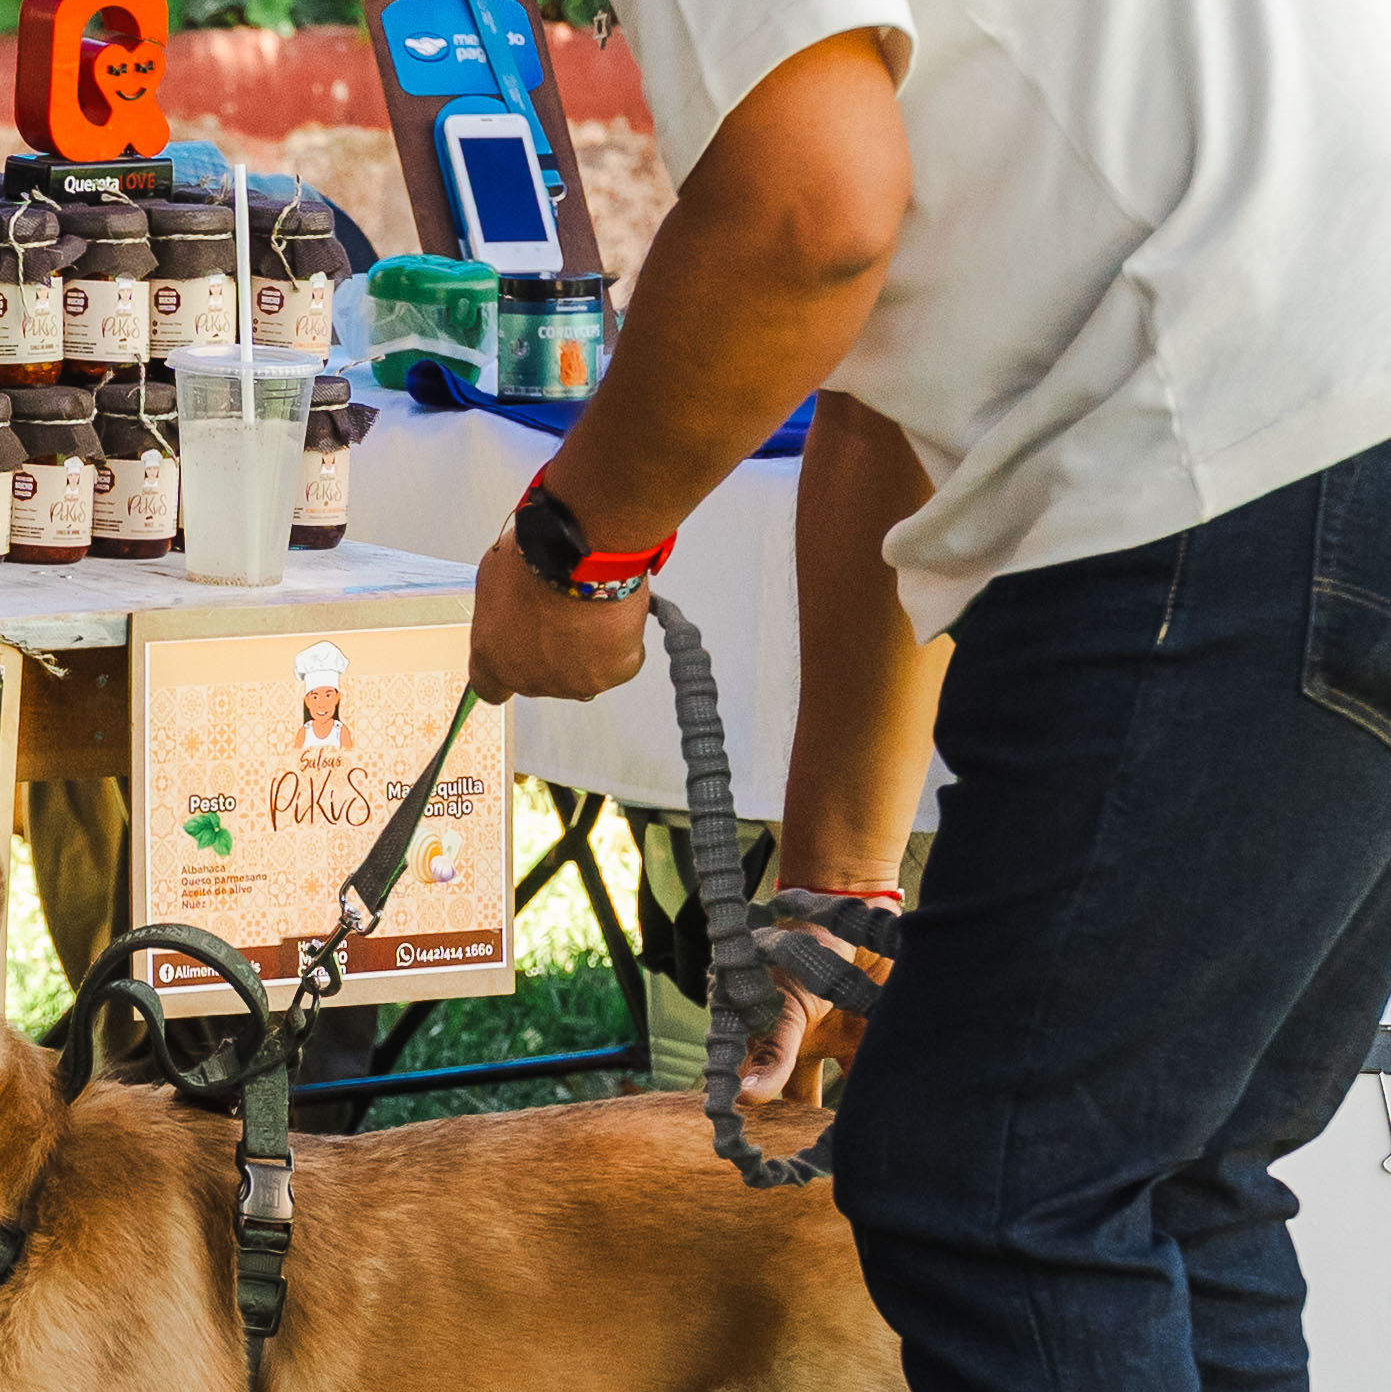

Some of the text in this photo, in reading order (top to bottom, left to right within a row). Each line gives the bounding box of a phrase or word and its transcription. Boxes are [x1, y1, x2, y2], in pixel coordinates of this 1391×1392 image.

[300, 748, 343, 772] Salsas
[189, 793, 237, 814] Pesto
[270, 767, 370, 832] PiKiS
[423, 795, 473, 819] on ajo
[181, 864, 226, 875] Albahaca
[181, 873, 268, 886] Queso parmesano
[181, 888, 212, 898] Aceite
[214, 887, 227, 896] de
[465, 943, 494, 958] 1660
